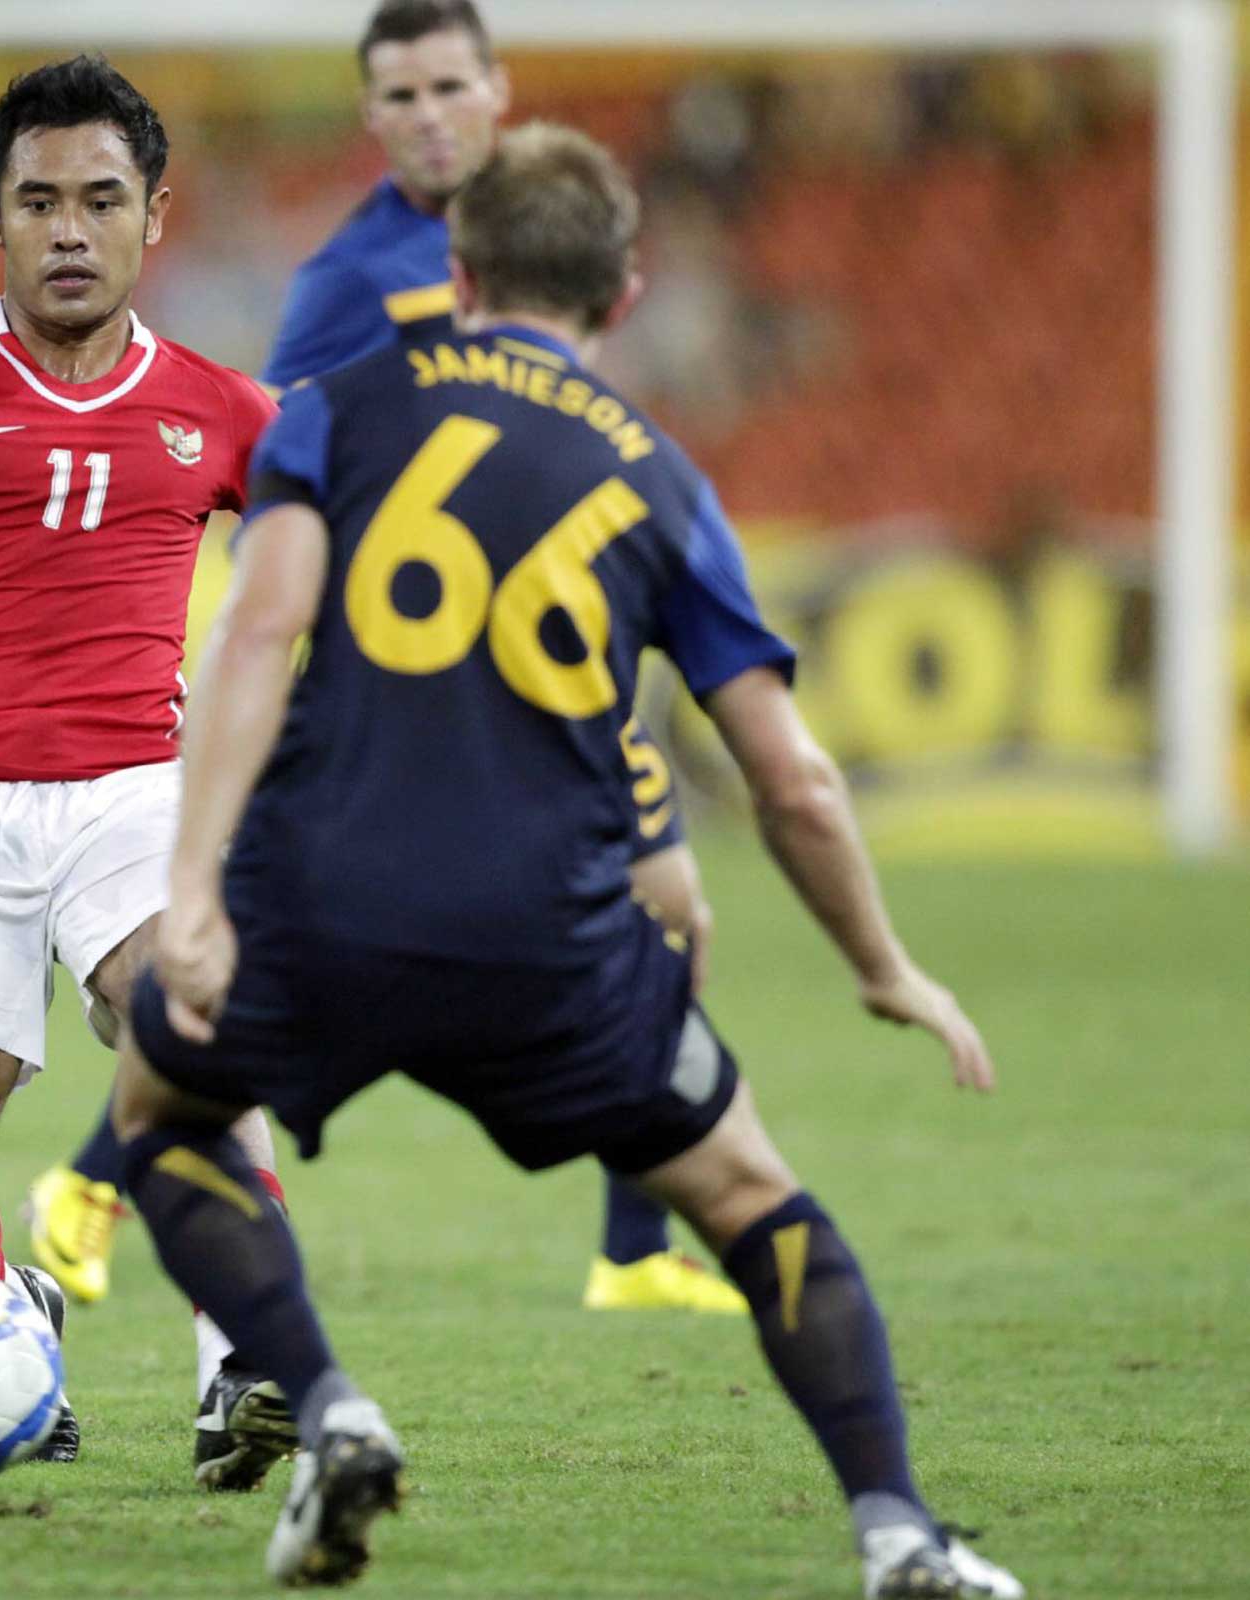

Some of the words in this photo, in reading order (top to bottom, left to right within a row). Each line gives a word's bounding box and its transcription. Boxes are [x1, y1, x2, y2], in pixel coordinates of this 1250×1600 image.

[406, 342, 655, 464] JAMIESON
[42, 448, 111, 531] 11
[344, 413, 650, 719] 66
